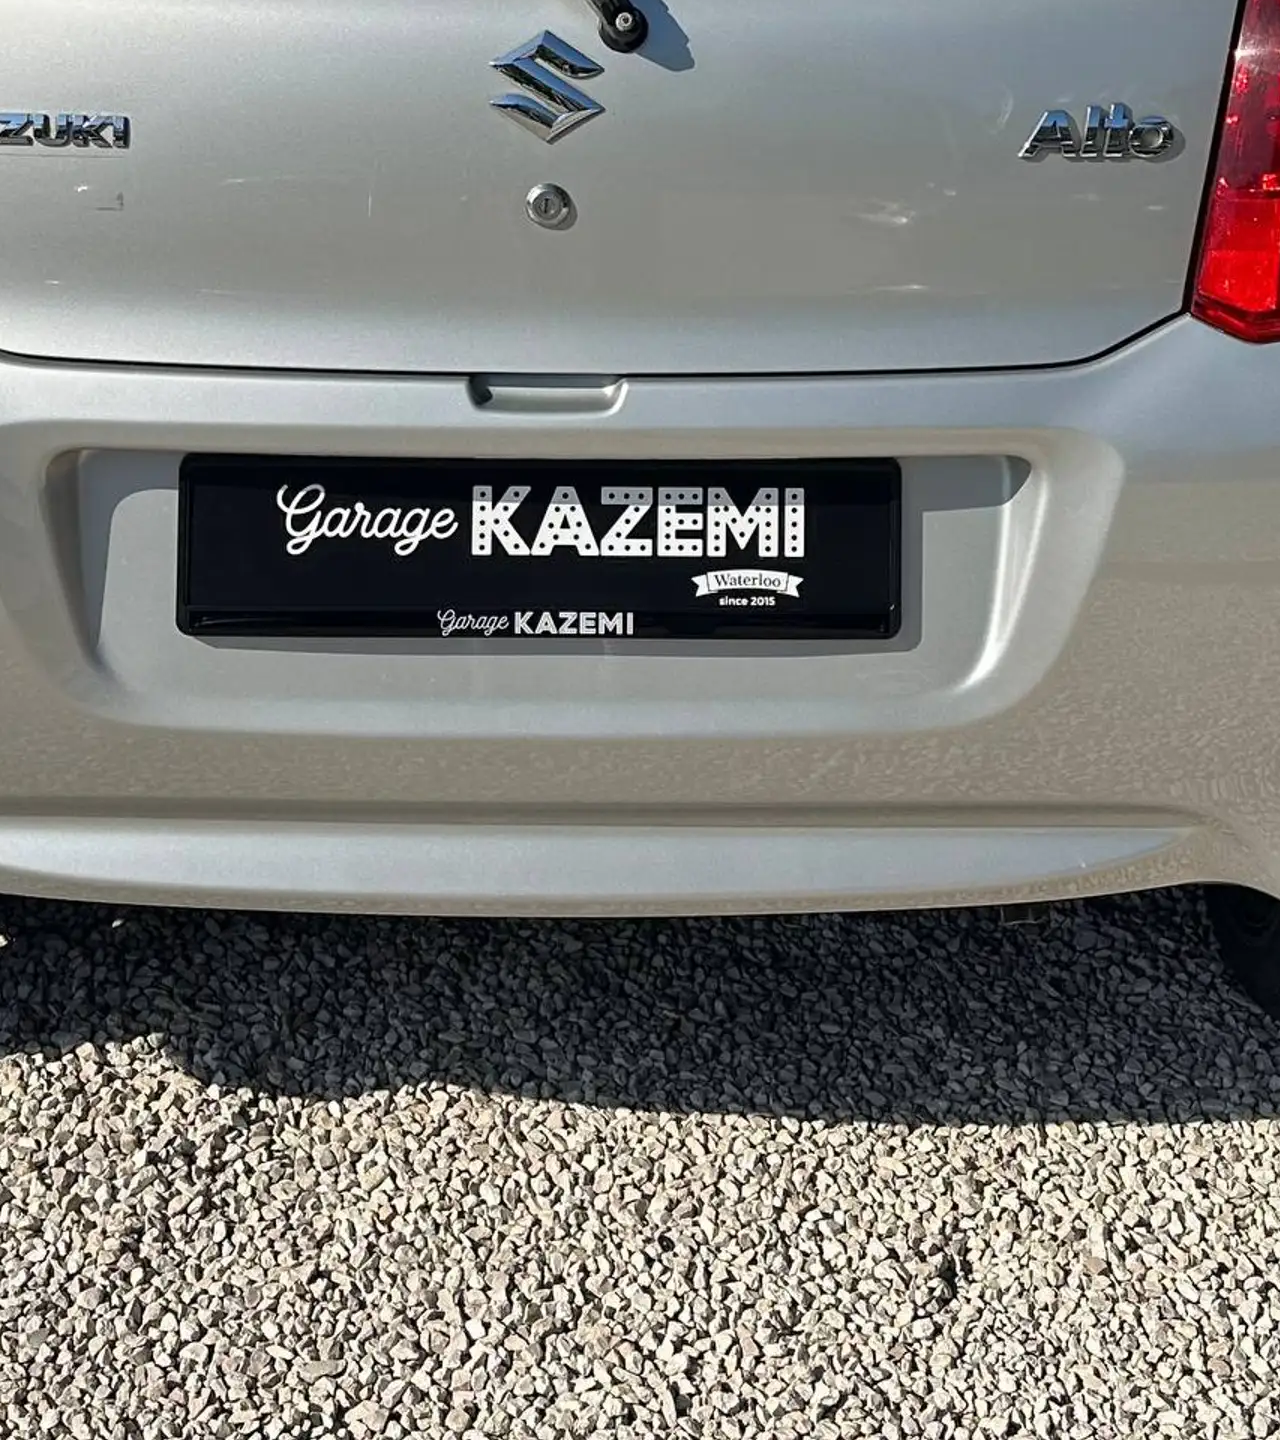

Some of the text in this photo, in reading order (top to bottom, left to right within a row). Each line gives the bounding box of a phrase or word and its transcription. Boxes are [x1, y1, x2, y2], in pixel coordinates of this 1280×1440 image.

[1018, 102, 1174, 159] Alto
[276, 483, 805, 557] Garage KAZEMI
[714, 572, 781, 587] Waterloo
[719, 596, 776, 606] since 2015
[437, 608, 635, 637] Garage KAZEMI
